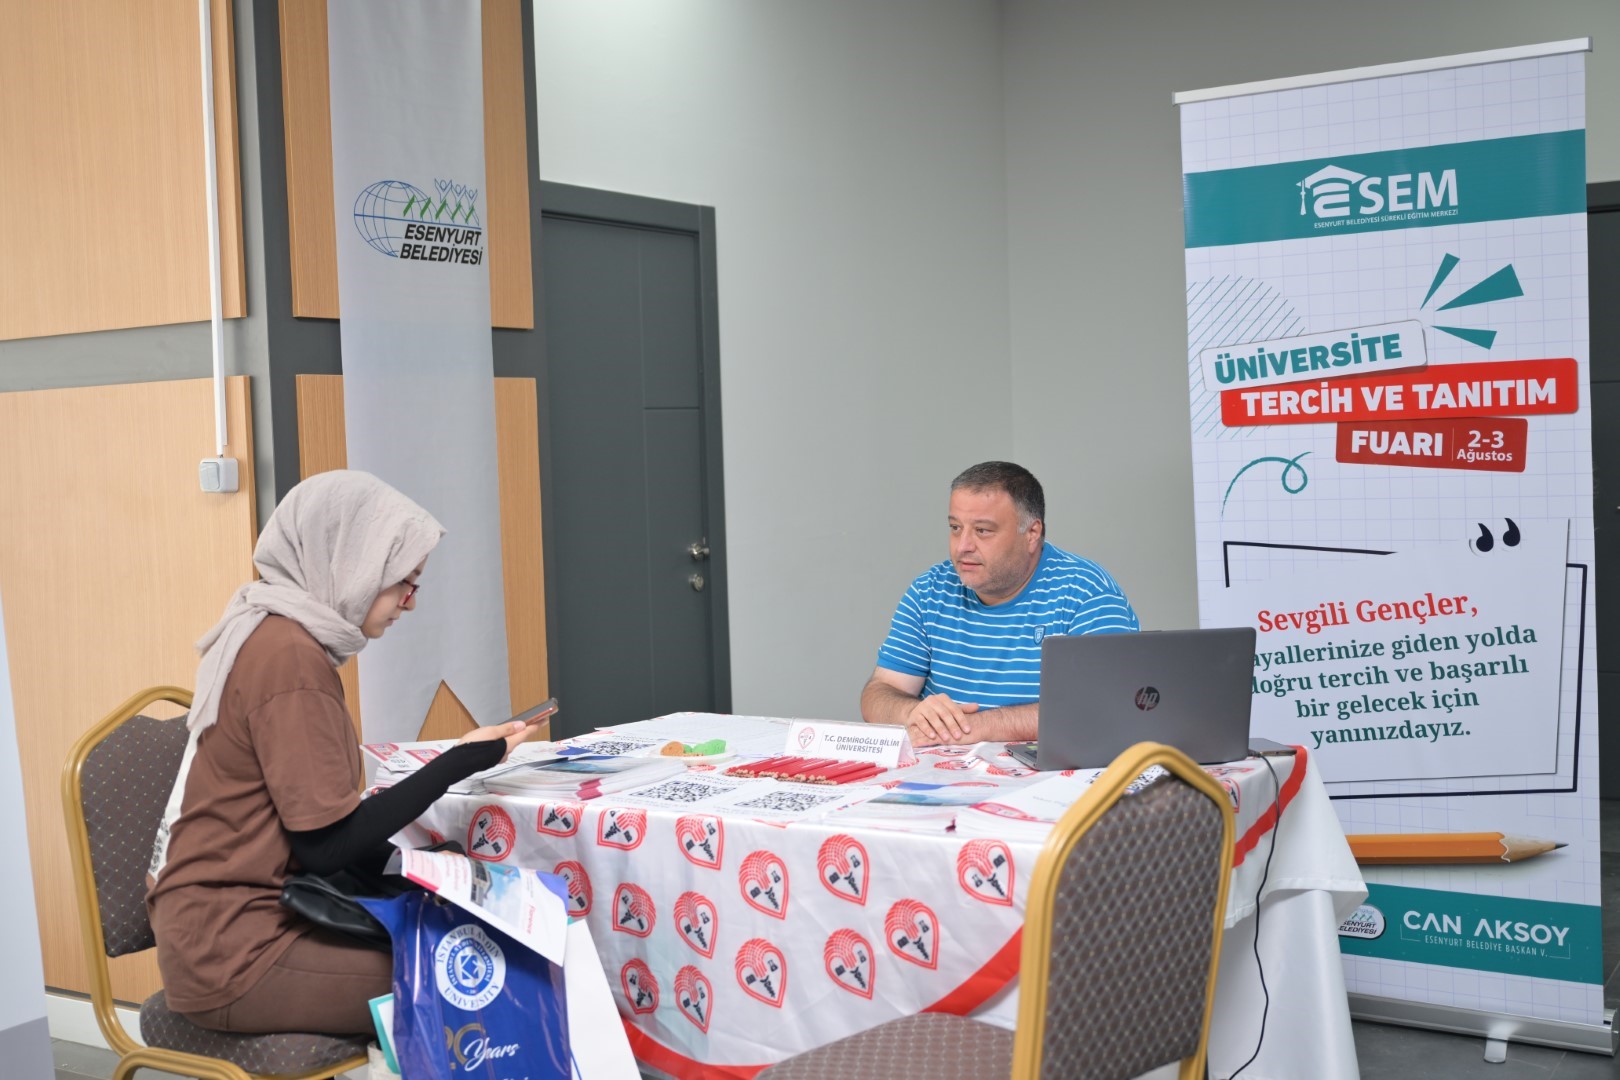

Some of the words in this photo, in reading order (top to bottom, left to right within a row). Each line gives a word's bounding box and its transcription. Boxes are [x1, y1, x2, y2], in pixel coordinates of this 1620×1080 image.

[1314, 219, 1345, 229] ESENYURT
[1346, 215, 1380, 226] BELEDİYESİ
[1381, 213, 1407, 222] SÜREKLİ
[1407, 211, 1429, 220] EĞİTİM
[1431, 208, 1459, 218] MERKEZİ
[404, 224, 482, 246] ESENYURT
[400, 243, 483, 266] BELEDİYESİ
[1214, 332, 1403, 384] ÜNİVERSİTE
[1241, 381, 1353, 417] TERCİH
[1360, 385, 1404, 412] VE
[1412, 377, 1557, 410] TANITIM
[1351, 430, 1444, 457] FUARI
[1468, 430, 1505, 449] 2-3
[1456, 448, 1513, 463] Ağustos
[1257, 602, 1348, 634] Sevgili
[1356, 592, 1479, 626] Gençler,
[1253, 640, 1385, 671] ayallerinize
[1392, 632, 1460, 661] giden
[1465, 624, 1538, 653] yolda
[1317, 662, 1390, 690] tercih
[1394, 667, 1424, 684] ve
[1430, 654, 1530, 685] başarılı
[1136, 687, 1159, 711] hp
[1295, 698, 1332, 718] bir
[1336, 690, 1428, 721] gelecek
[1431, 687, 1480, 711] için
[825, 734, 836, 743] T.C.
[837, 736, 878, 746] DEMİROĞLU
[879, 738, 900, 747] BİLİM
[1310, 717, 1472, 750] yanınızdayız.
[836, 743, 883, 754] ÜNİVERSİTESİ
[1343, 920, 1377, 929] SENYURT
[1403, 910, 1462, 935] CAN
[1474, 918, 1570, 947] AKSOY
[1424, 935, 1463, 947] ESENYURT
[463, 1036, 520, 1072] Years
